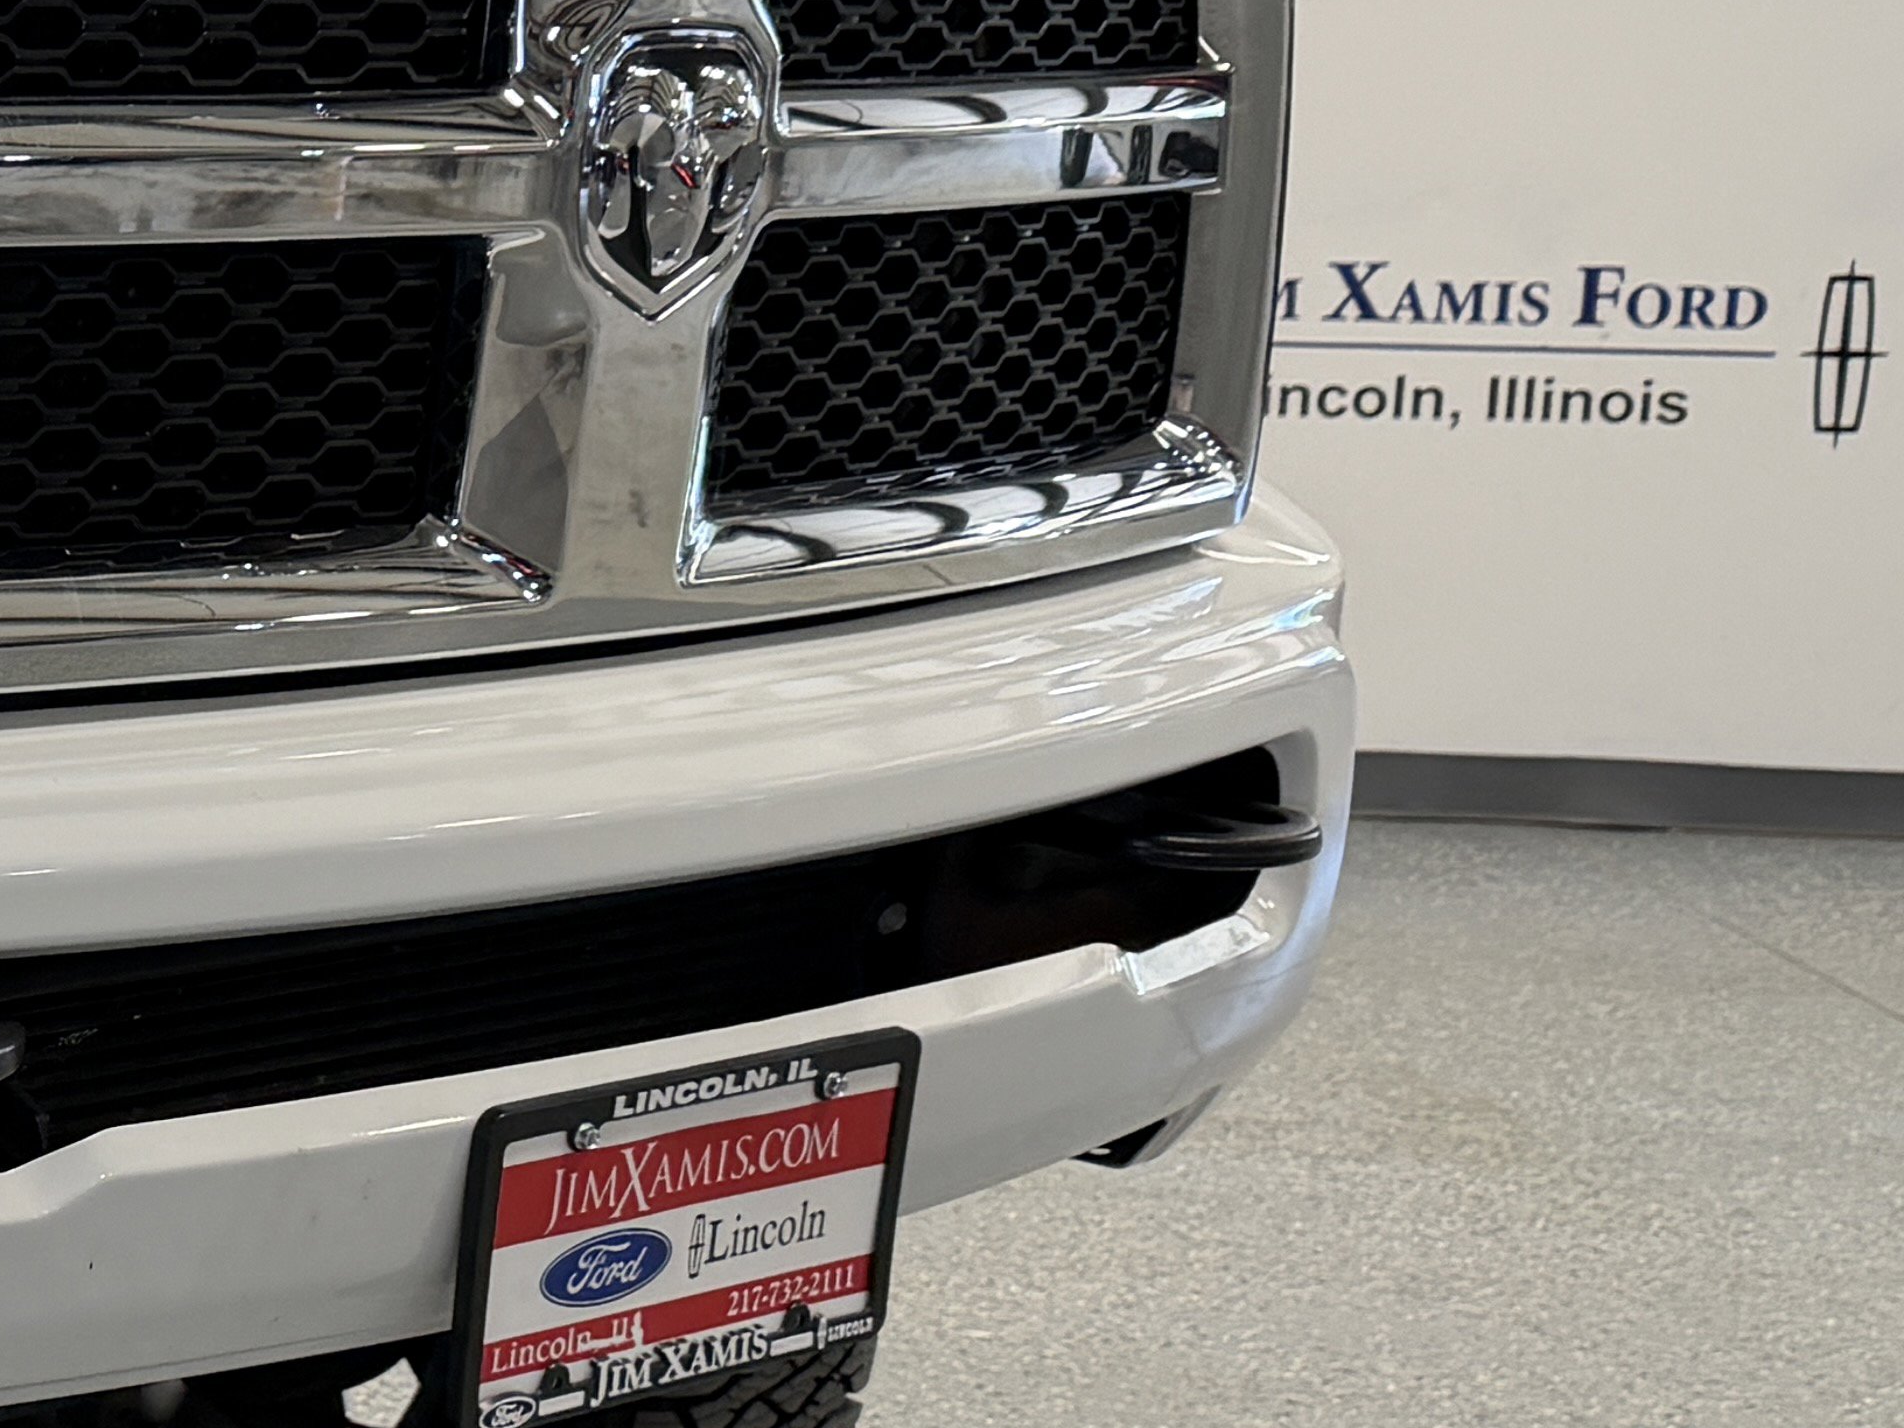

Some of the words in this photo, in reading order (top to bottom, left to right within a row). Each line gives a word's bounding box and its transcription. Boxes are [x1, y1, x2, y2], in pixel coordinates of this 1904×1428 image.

[1322, 261, 1550, 326] XAMIS
[1572, 266, 1768, 330] FORD
[1262, 375, 1462, 429] incoln,
[1487, 375, 1689, 426] Illinois
[613, 1066, 777, 1118] LINCOLN,
[787, 1057, 819, 1082] IL
[544, 1117, 841, 1235] JIMXAMIS.COM
[566, 1240, 648, 1295] Ford
[704, 1201, 827, 1265] Lincoln
[727, 1264, 855, 1318] 217-732-2111
[590, 1356, 654, 1408] JIM
[659, 1327, 769, 1385] XAMIS
